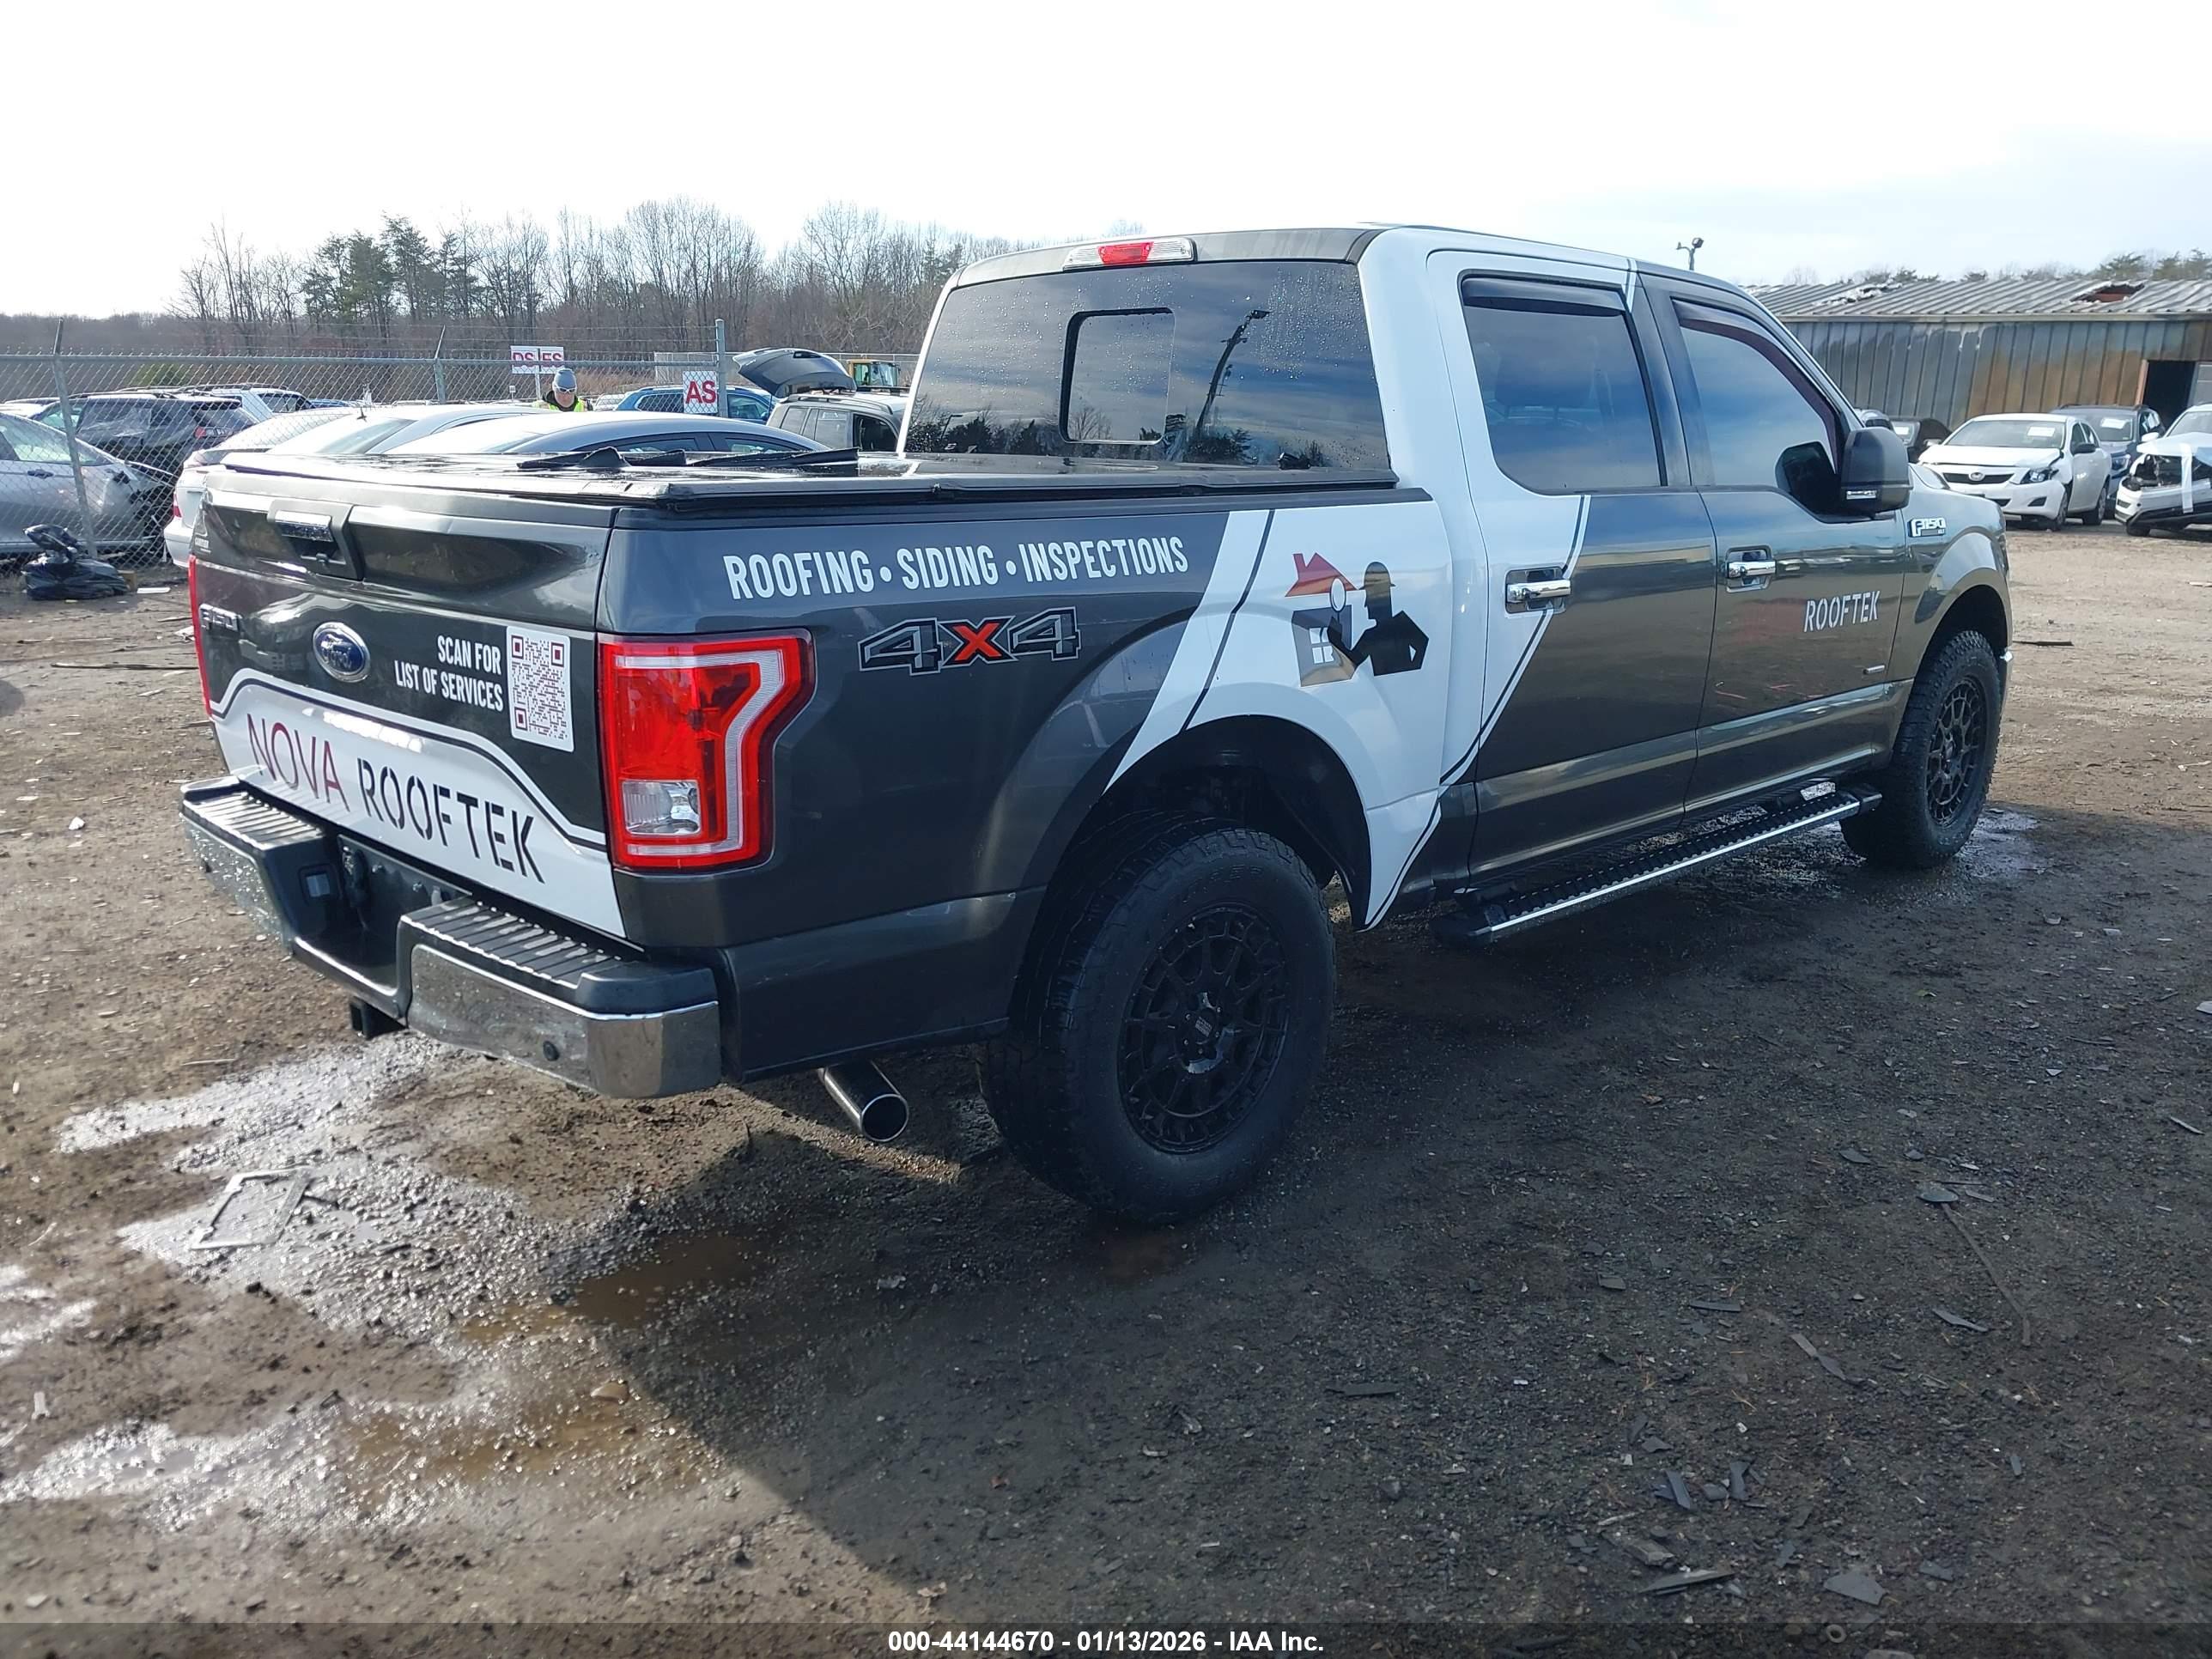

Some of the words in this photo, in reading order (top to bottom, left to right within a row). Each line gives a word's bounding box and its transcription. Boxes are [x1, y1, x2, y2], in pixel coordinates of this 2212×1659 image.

[686, 380, 717, 404] AS
[723, 550, 874, 599] ROOFING
[896, 544, 999, 590] SIDING
[1018, 536, 1188, 582] INSPECTIONS
[1803, 590, 1881, 633] ROOFTEK
[436, 635, 471, 669] SCAN
[474, 642, 502, 676] FOR
[394, 659, 420, 691] LIST
[422, 666, 439, 695] OF
[440, 671, 504, 712] SERVICES
[246, 713, 351, 812] NOVA
[356, 757, 545, 884] ROOFTEK
